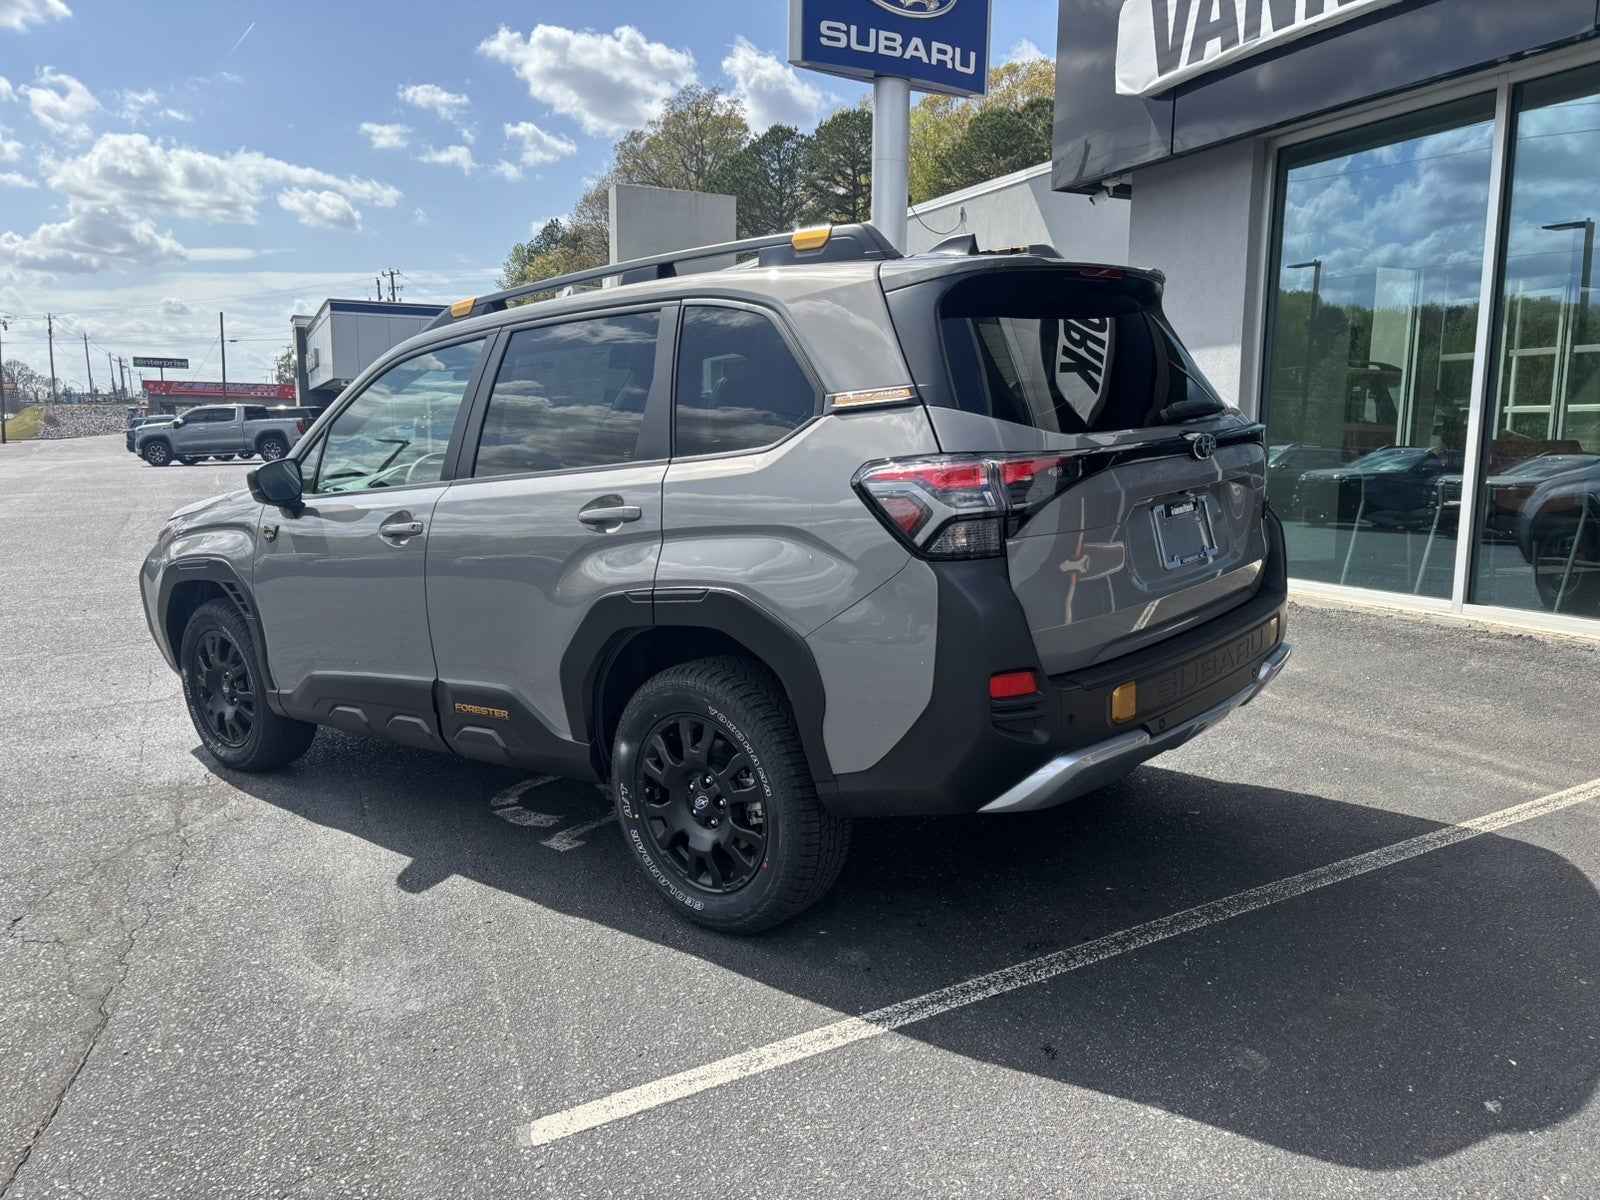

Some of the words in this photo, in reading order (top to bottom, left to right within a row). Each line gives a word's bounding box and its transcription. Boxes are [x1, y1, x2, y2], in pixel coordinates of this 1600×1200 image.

[820, 20, 976, 75] SUBARU
[134, 358, 188, 368] enterprise
[1158, 629, 1263, 698] SUBARU
[454, 703, 509, 719] FORESTER
[708, 705, 772, 797] YOKOHAMA
[630, 829, 704, 911] GEOLANDAR
